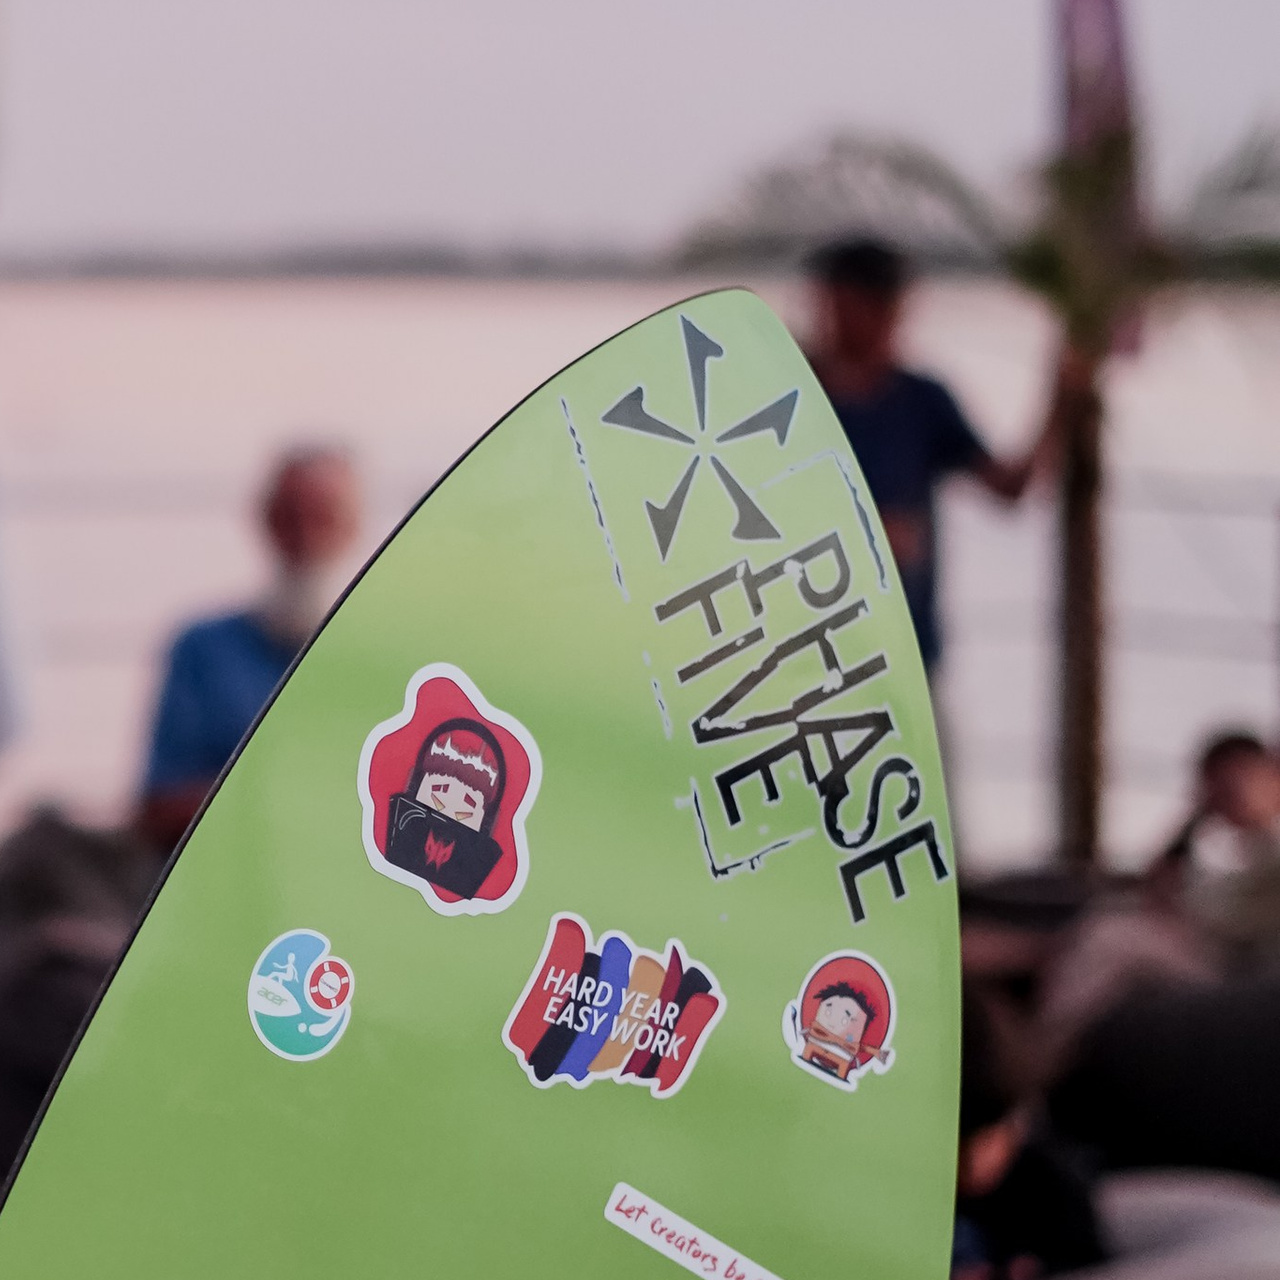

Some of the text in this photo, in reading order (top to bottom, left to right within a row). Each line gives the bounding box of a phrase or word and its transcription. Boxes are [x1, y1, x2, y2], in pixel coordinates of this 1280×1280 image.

[655, 559, 819, 826] FIVE
[750, 531, 949, 923] PHASE
[257, 986, 288, 1007] acer
[543, 965, 680, 1030] HARD YEAR
[543, 996, 686, 1061] EASY WORK
[614, 1194, 649, 1222] Let
